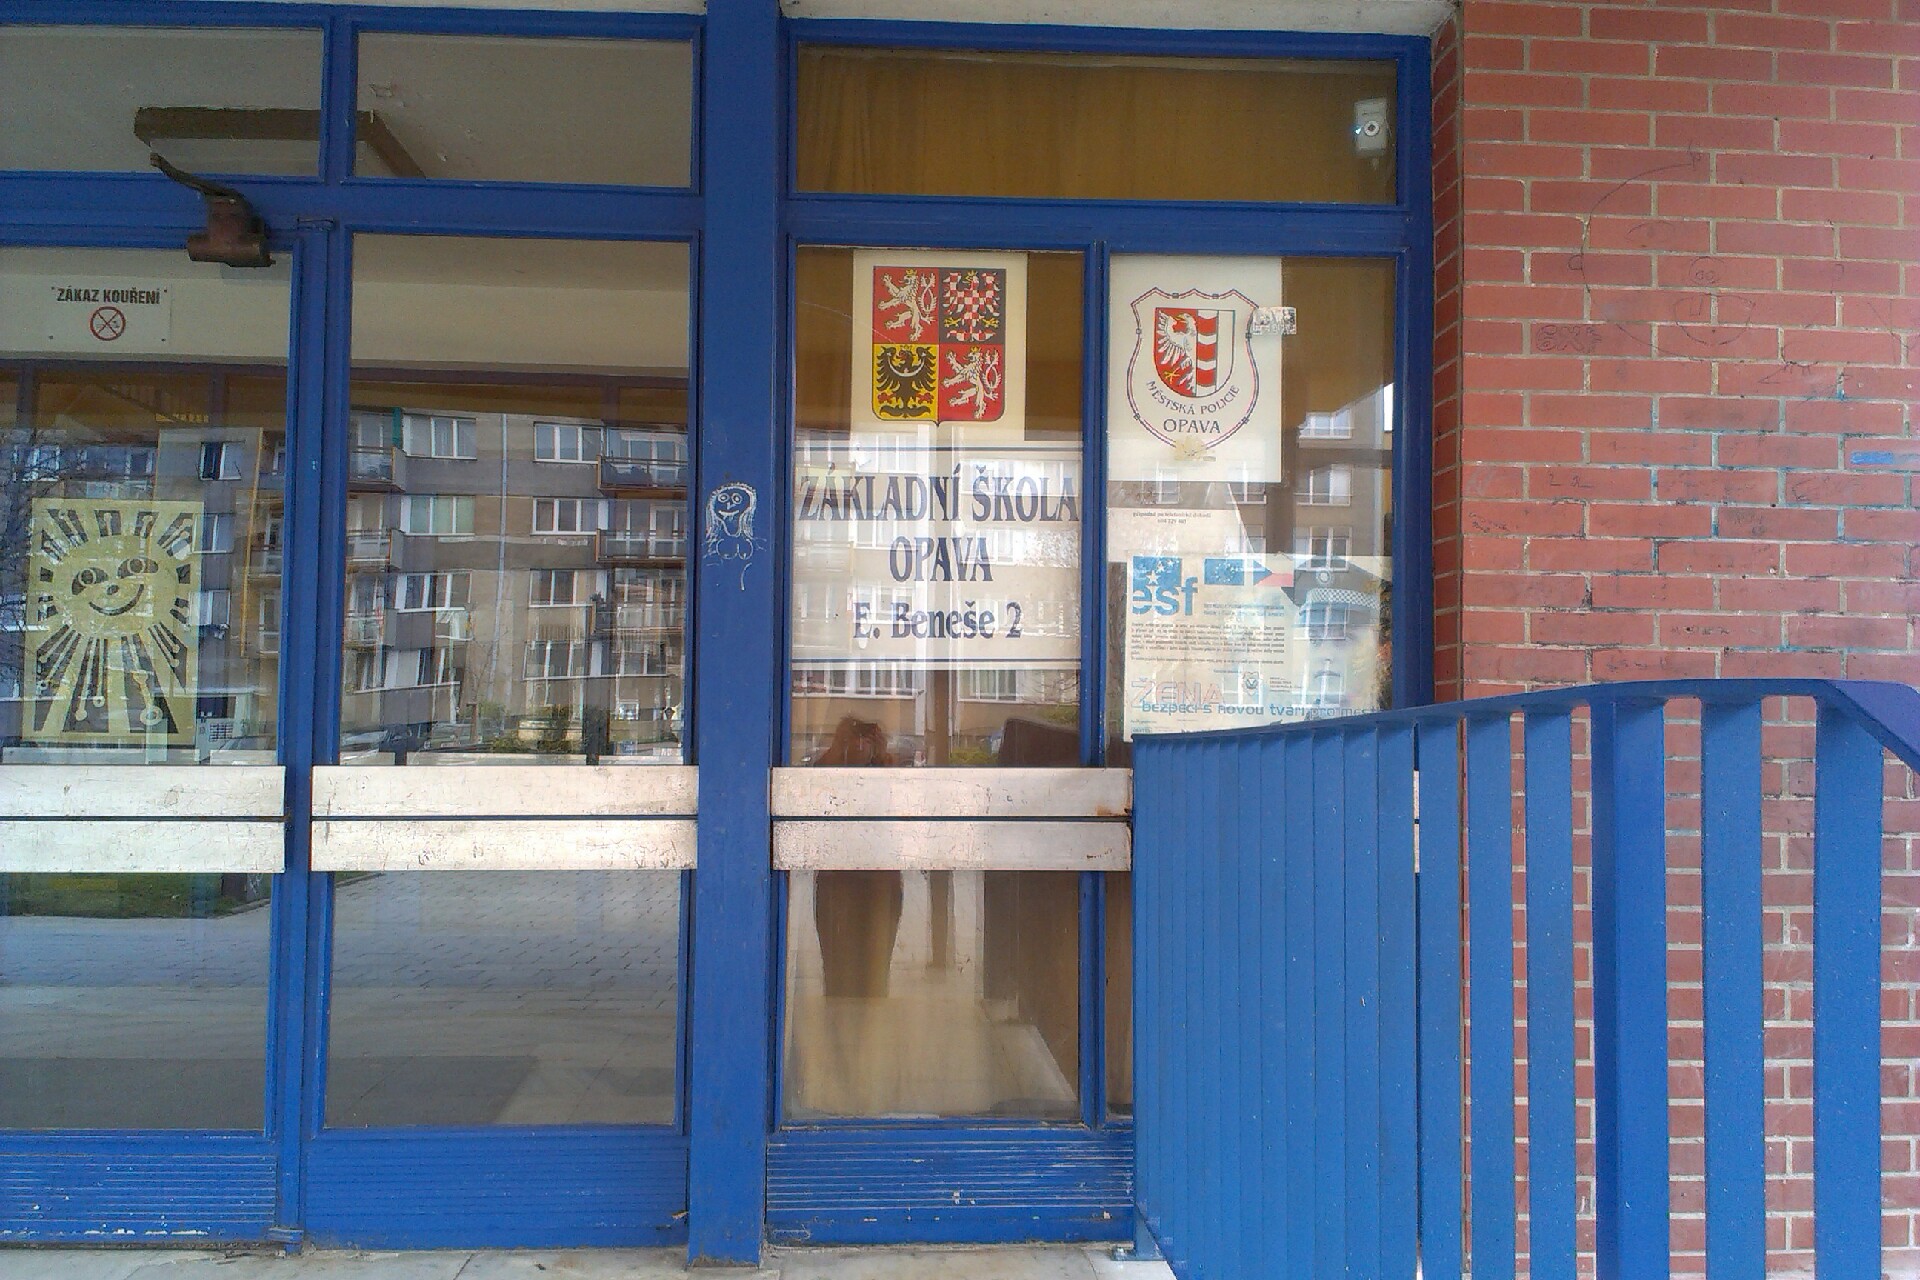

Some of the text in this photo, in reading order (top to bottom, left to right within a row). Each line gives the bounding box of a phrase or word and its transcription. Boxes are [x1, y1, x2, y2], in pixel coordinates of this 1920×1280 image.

[56, 285, 160, 305] ZÁKAZ KOUŘENÍ
[1146, 380, 1240, 415] MĚSTSKÁ POLICIE
[1163, 418, 1221, 434] OPAVA
[799, 462, 1080, 522] ZÁKLADNÍ ŠKOLA
[889, 535, 993, 583] OPAVA
[1132, 576, 1198, 616] esf
[853, 600, 1022, 639] E. Beneše 2
[1218, 703, 1265, 715] novou
